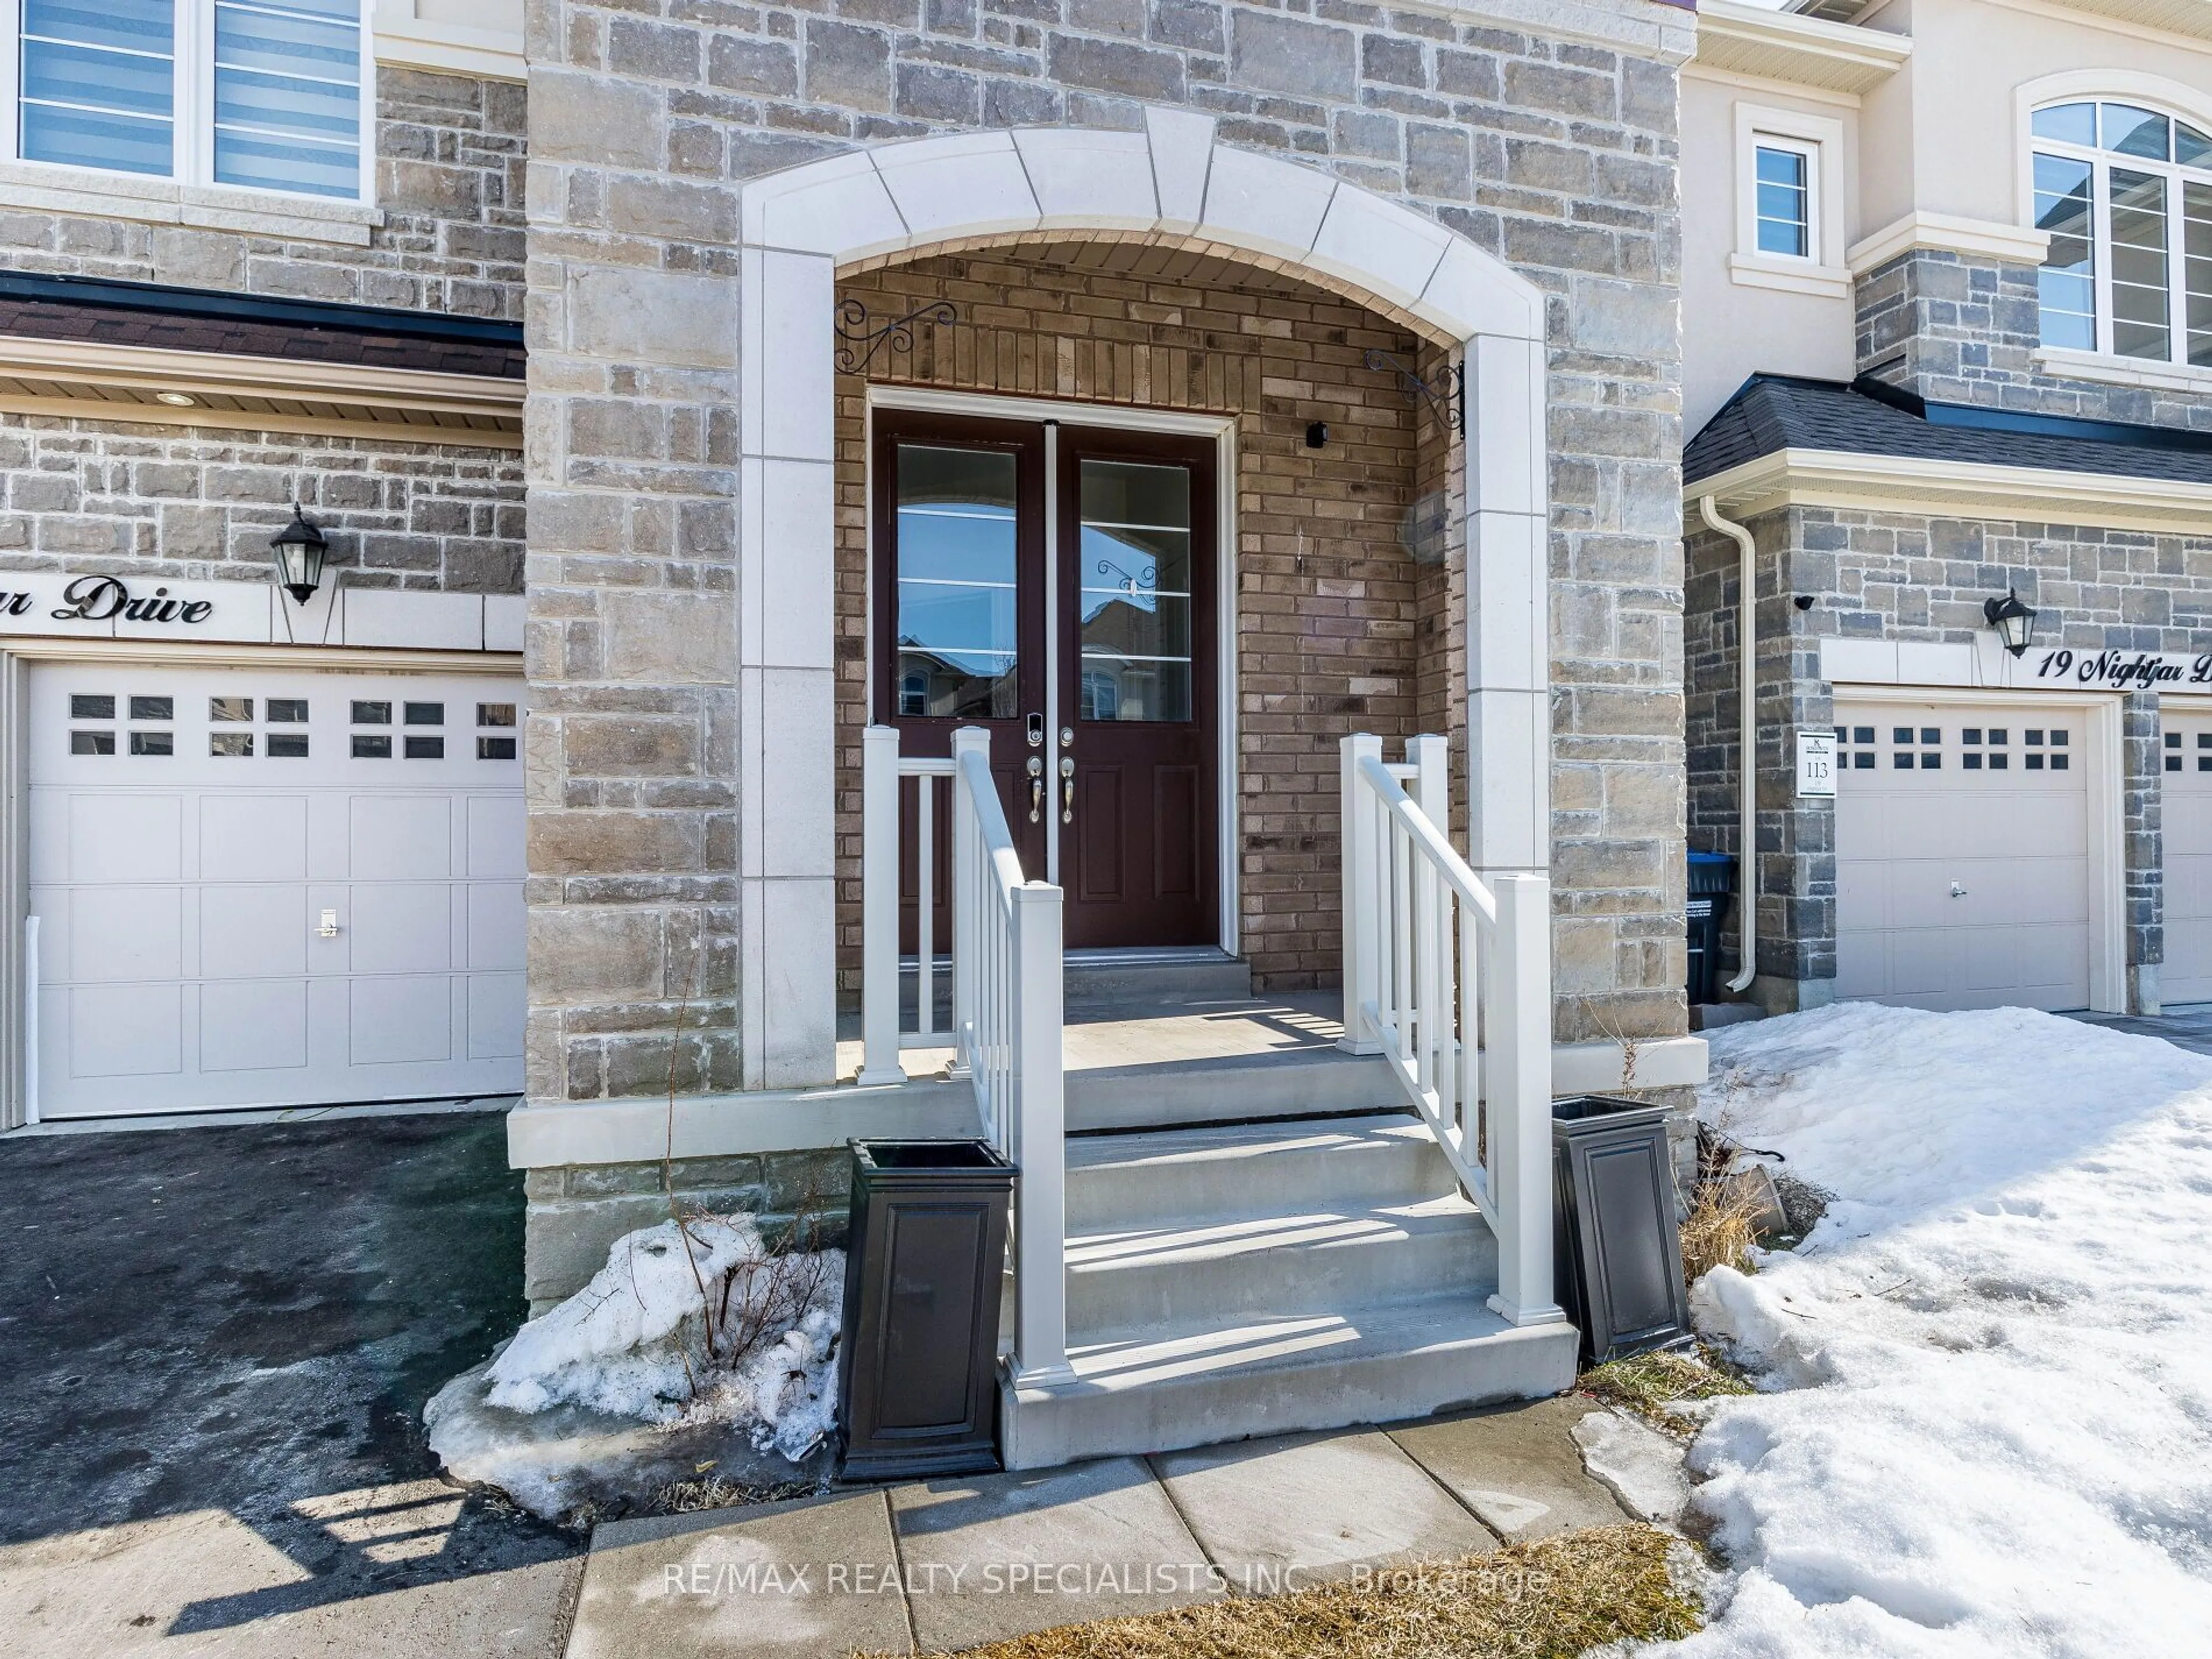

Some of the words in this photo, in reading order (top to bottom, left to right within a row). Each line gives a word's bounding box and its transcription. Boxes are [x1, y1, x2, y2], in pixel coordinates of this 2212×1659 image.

[51, 575, 213, 623] Drive
[2037, 650, 2073, 677] 19
[2077, 650, 2184, 689] Nightjar
[1808, 762, 1828, 778] 113
